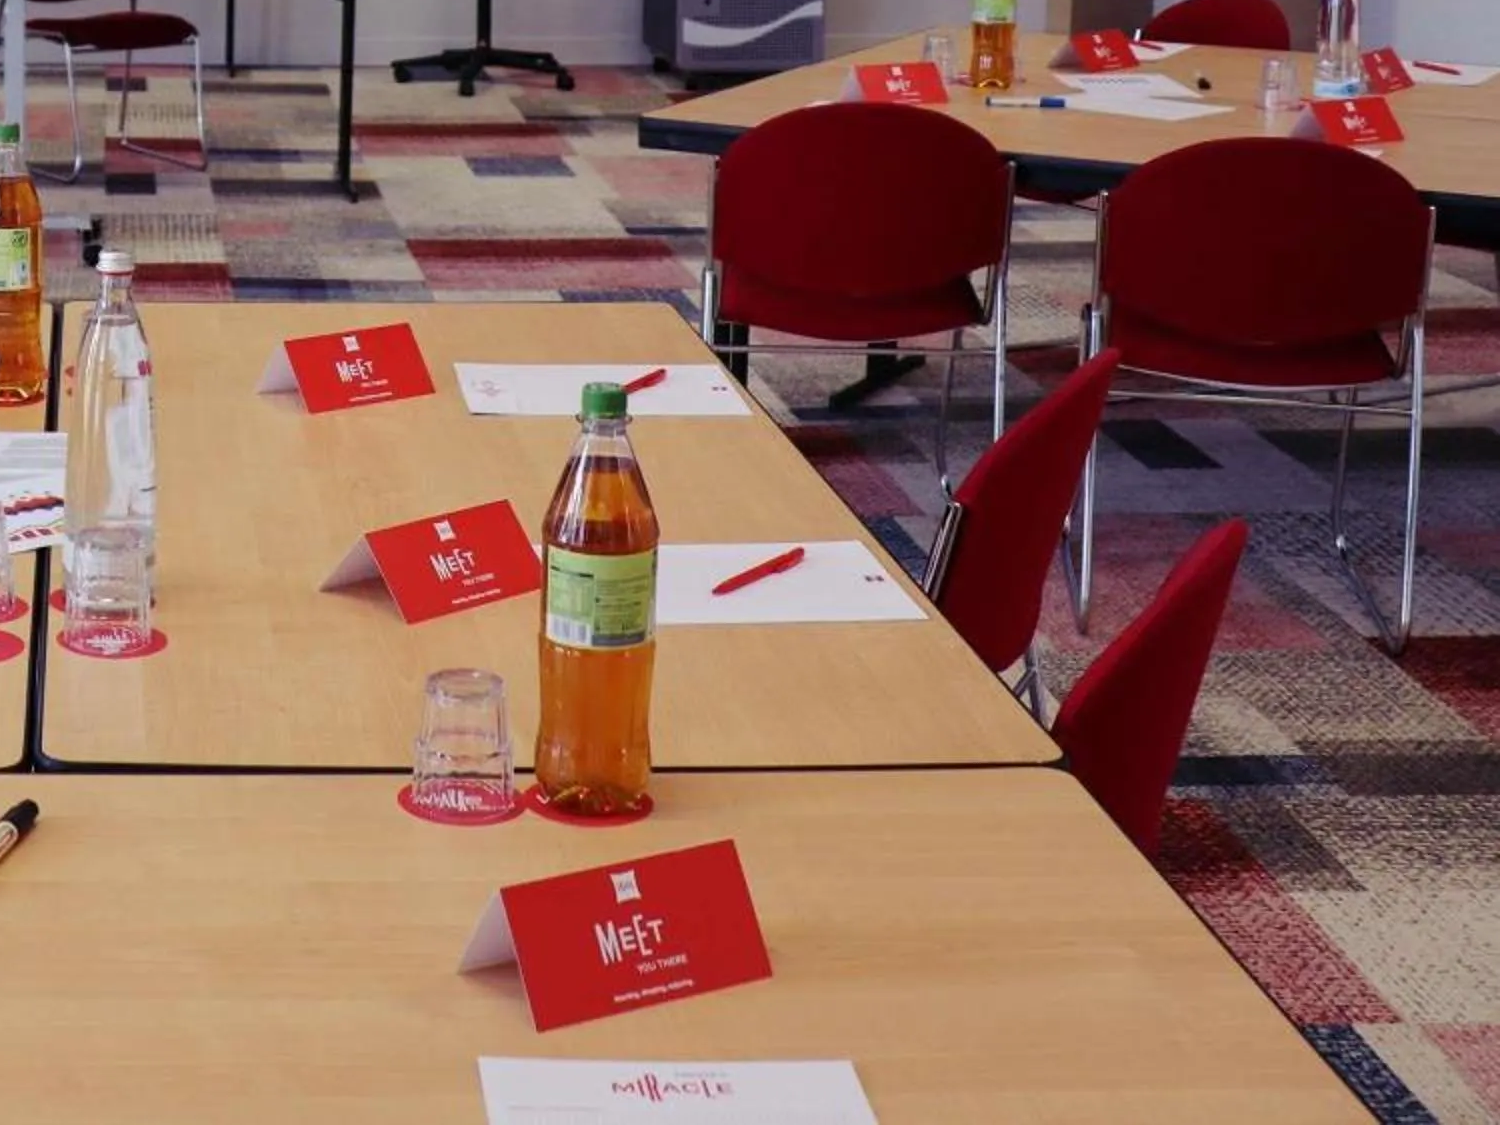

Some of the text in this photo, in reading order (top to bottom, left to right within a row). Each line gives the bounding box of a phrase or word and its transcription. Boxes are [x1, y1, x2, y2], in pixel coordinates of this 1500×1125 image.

[335, 358, 373, 383] MEET
[429, 548, 476, 582] MEET
[594, 914, 664, 966] MEET
